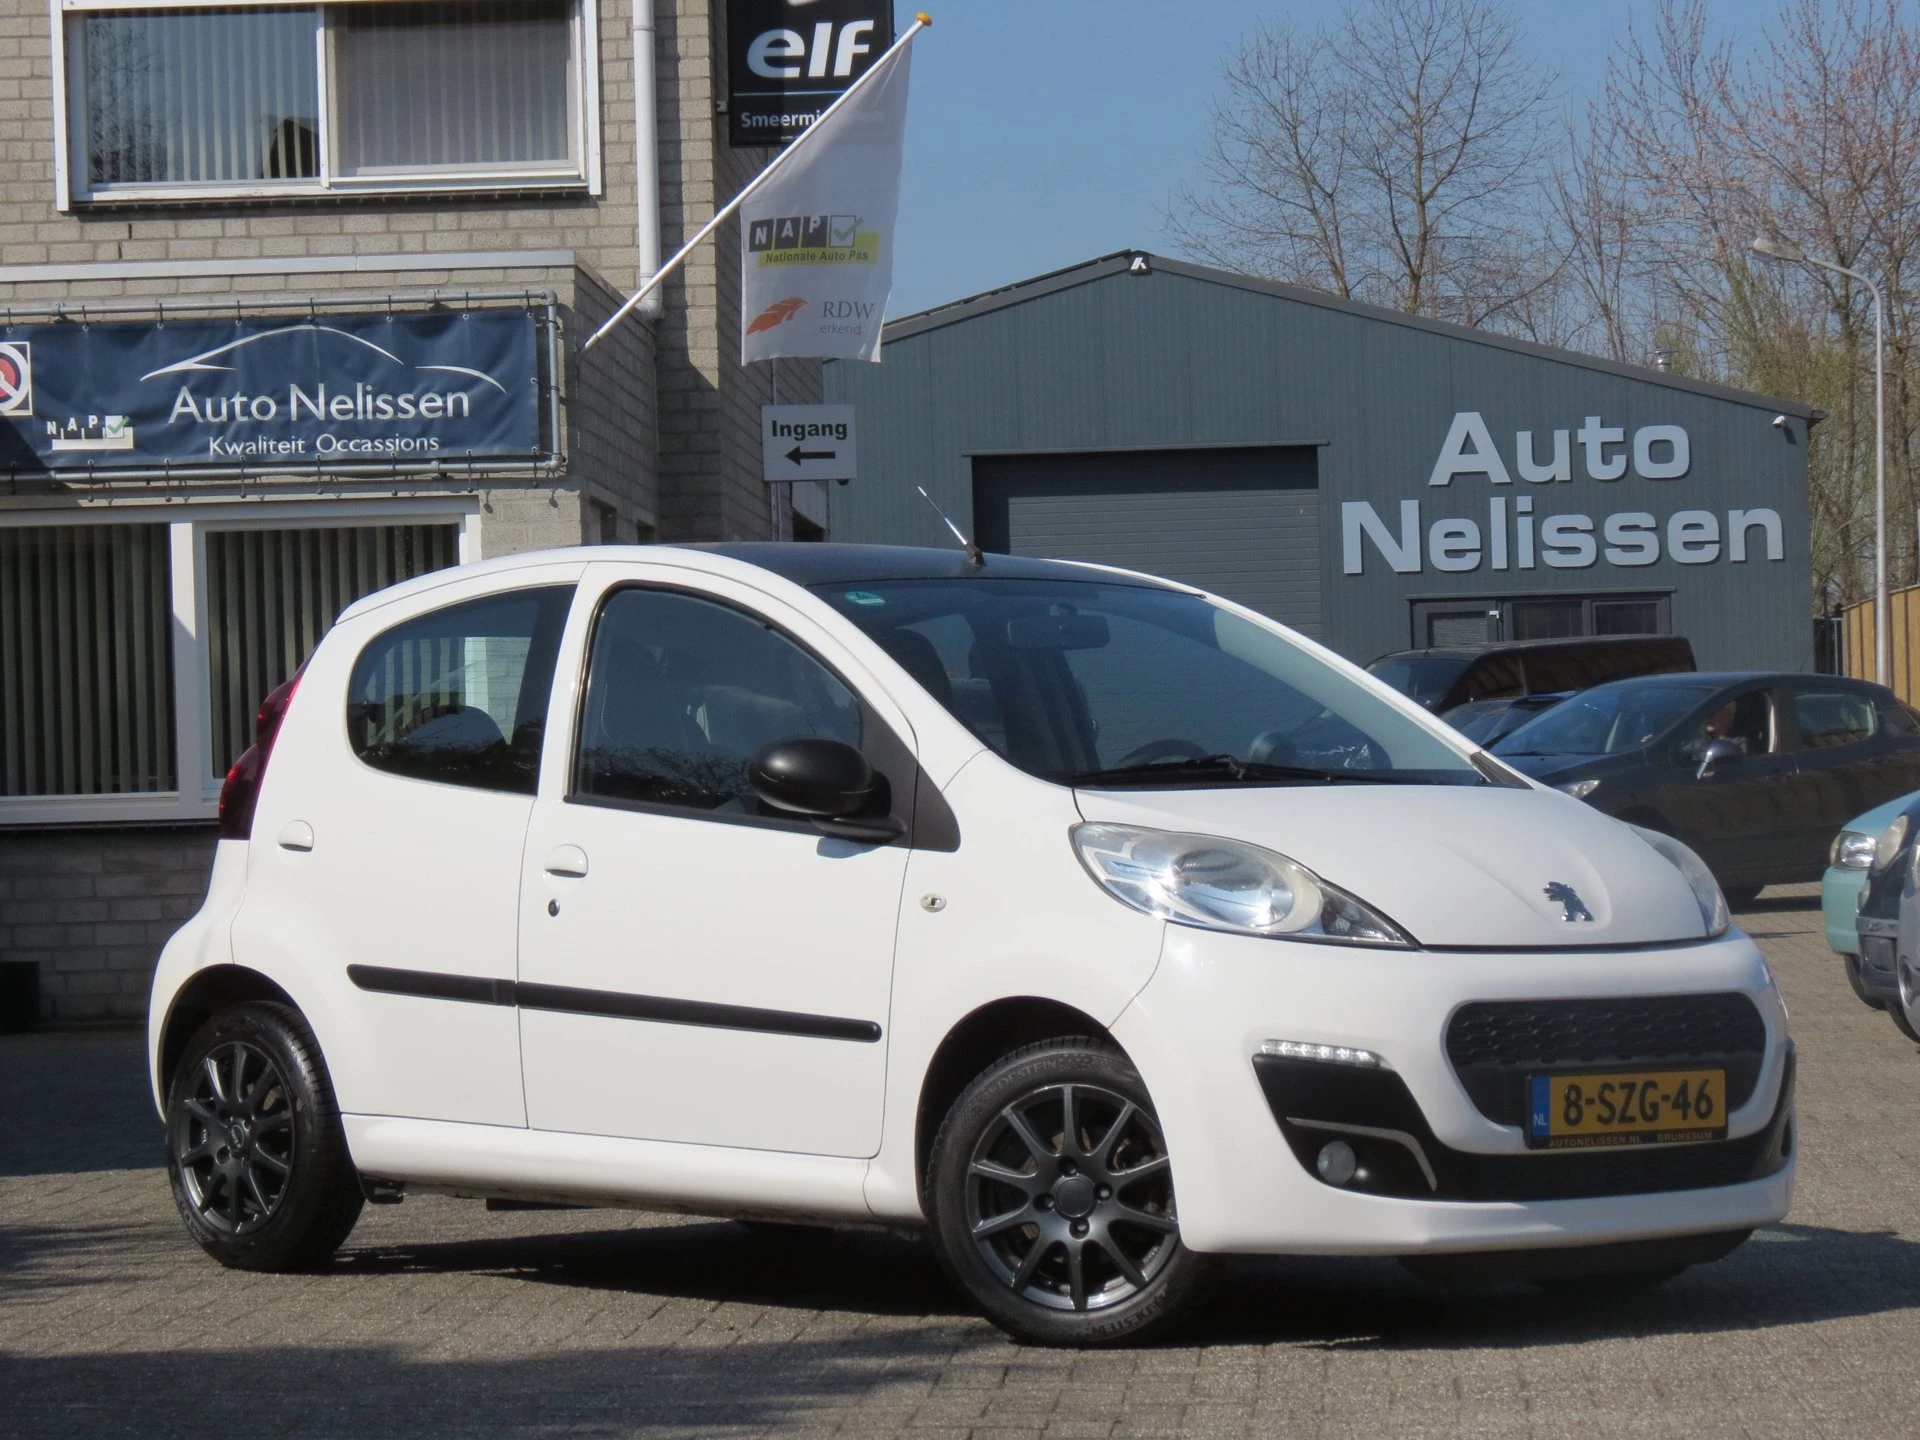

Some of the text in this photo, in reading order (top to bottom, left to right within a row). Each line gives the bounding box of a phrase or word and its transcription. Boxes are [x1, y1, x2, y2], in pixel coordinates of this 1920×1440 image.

[747, 20, 875, 79] elf
[741, 109, 821, 128] Smeermi
[766, 249, 869, 264] Nationale Auto Pas
[821, 301, 876, 320] RDW
[820, 324, 862, 336] erkend
[168, 382, 470, 424] Auto Nelissen
[771, 420, 848, 441] Ingang
[208, 432, 440, 457] Kwaliteit Occassions
[1428, 411, 1692, 486] Auto
[1341, 496, 1785, 575] Nelissen
[1533, 1077, 1714, 1127] NL 8-SZG-46
[1549, 1131, 1713, 1149] AUTONELISSEN.NL BRUNSSUM
